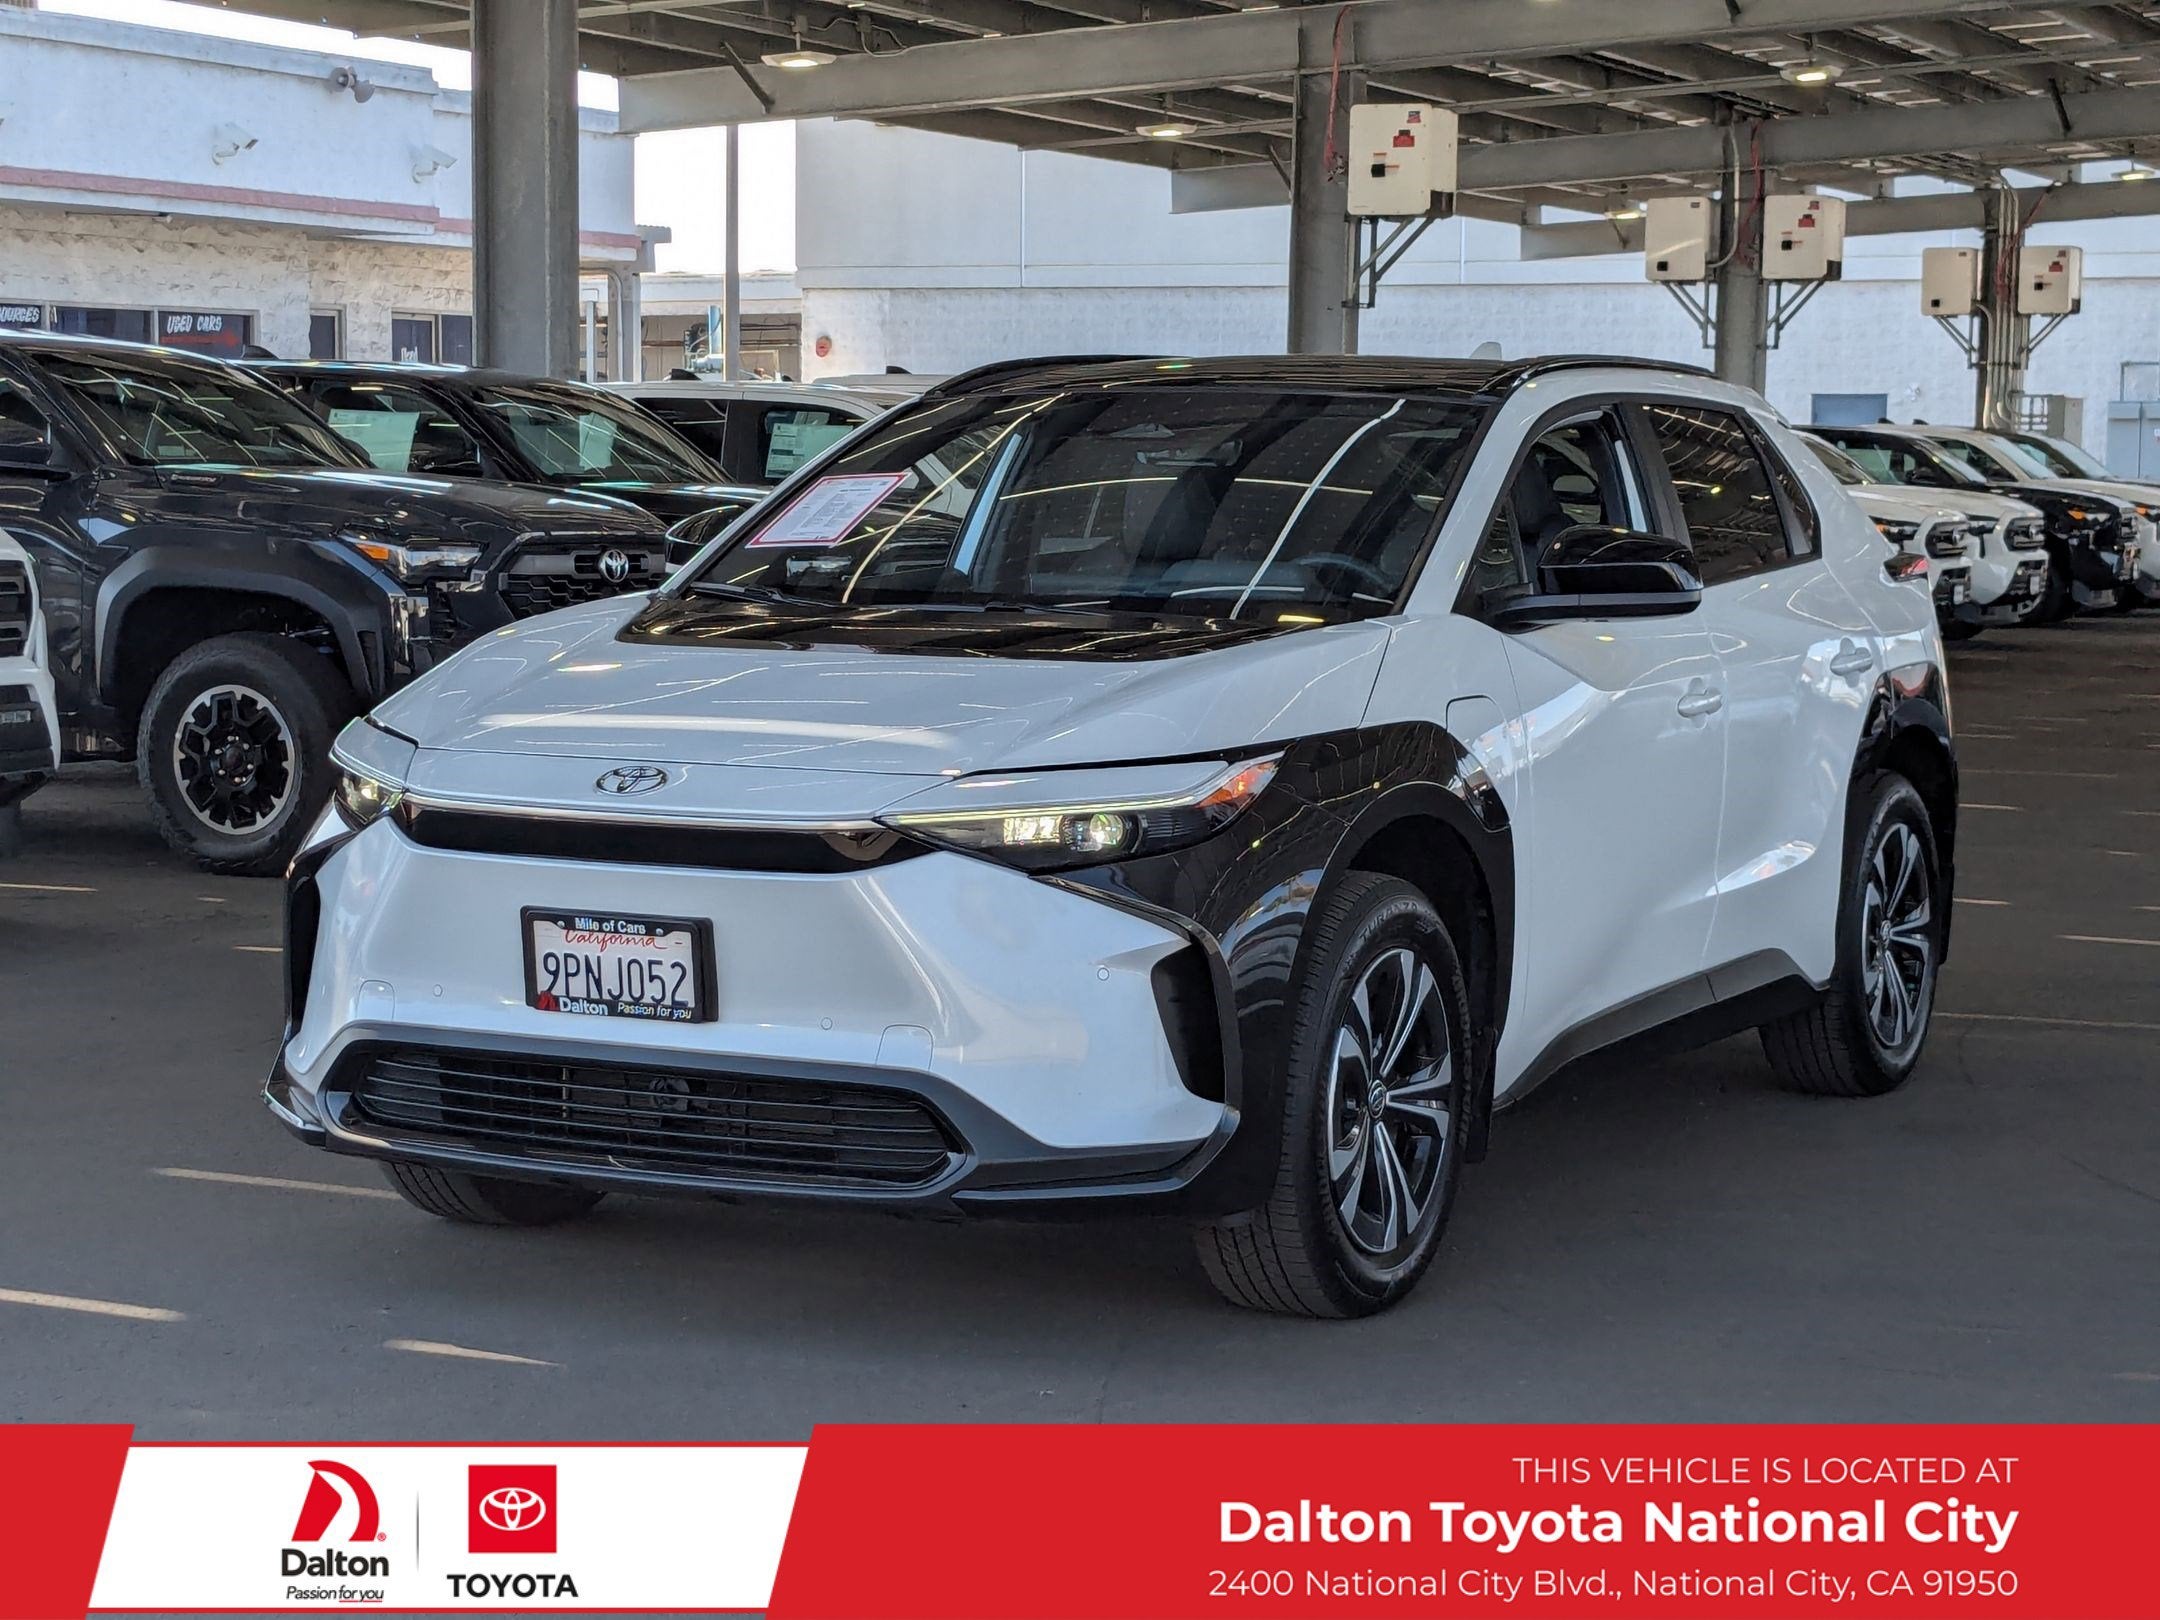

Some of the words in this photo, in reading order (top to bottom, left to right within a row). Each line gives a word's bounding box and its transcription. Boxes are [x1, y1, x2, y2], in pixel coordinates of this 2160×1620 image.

[0, 306, 40, 323] OURCES
[167, 315, 193, 334] USED
[197, 315, 222, 332] CARS
[575, 917, 599, 931] Mile
[602, 921, 615, 932] of
[617, 921, 646, 935] Cars
[565, 929, 667, 952] California
[543, 951, 688, 1007] 9PNJ052
[559, 997, 608, 1016] Dalton
[617, 1002, 654, 1016] Passion
[657, 1005, 671, 1016] for
[672, 1009, 691, 1020] you
